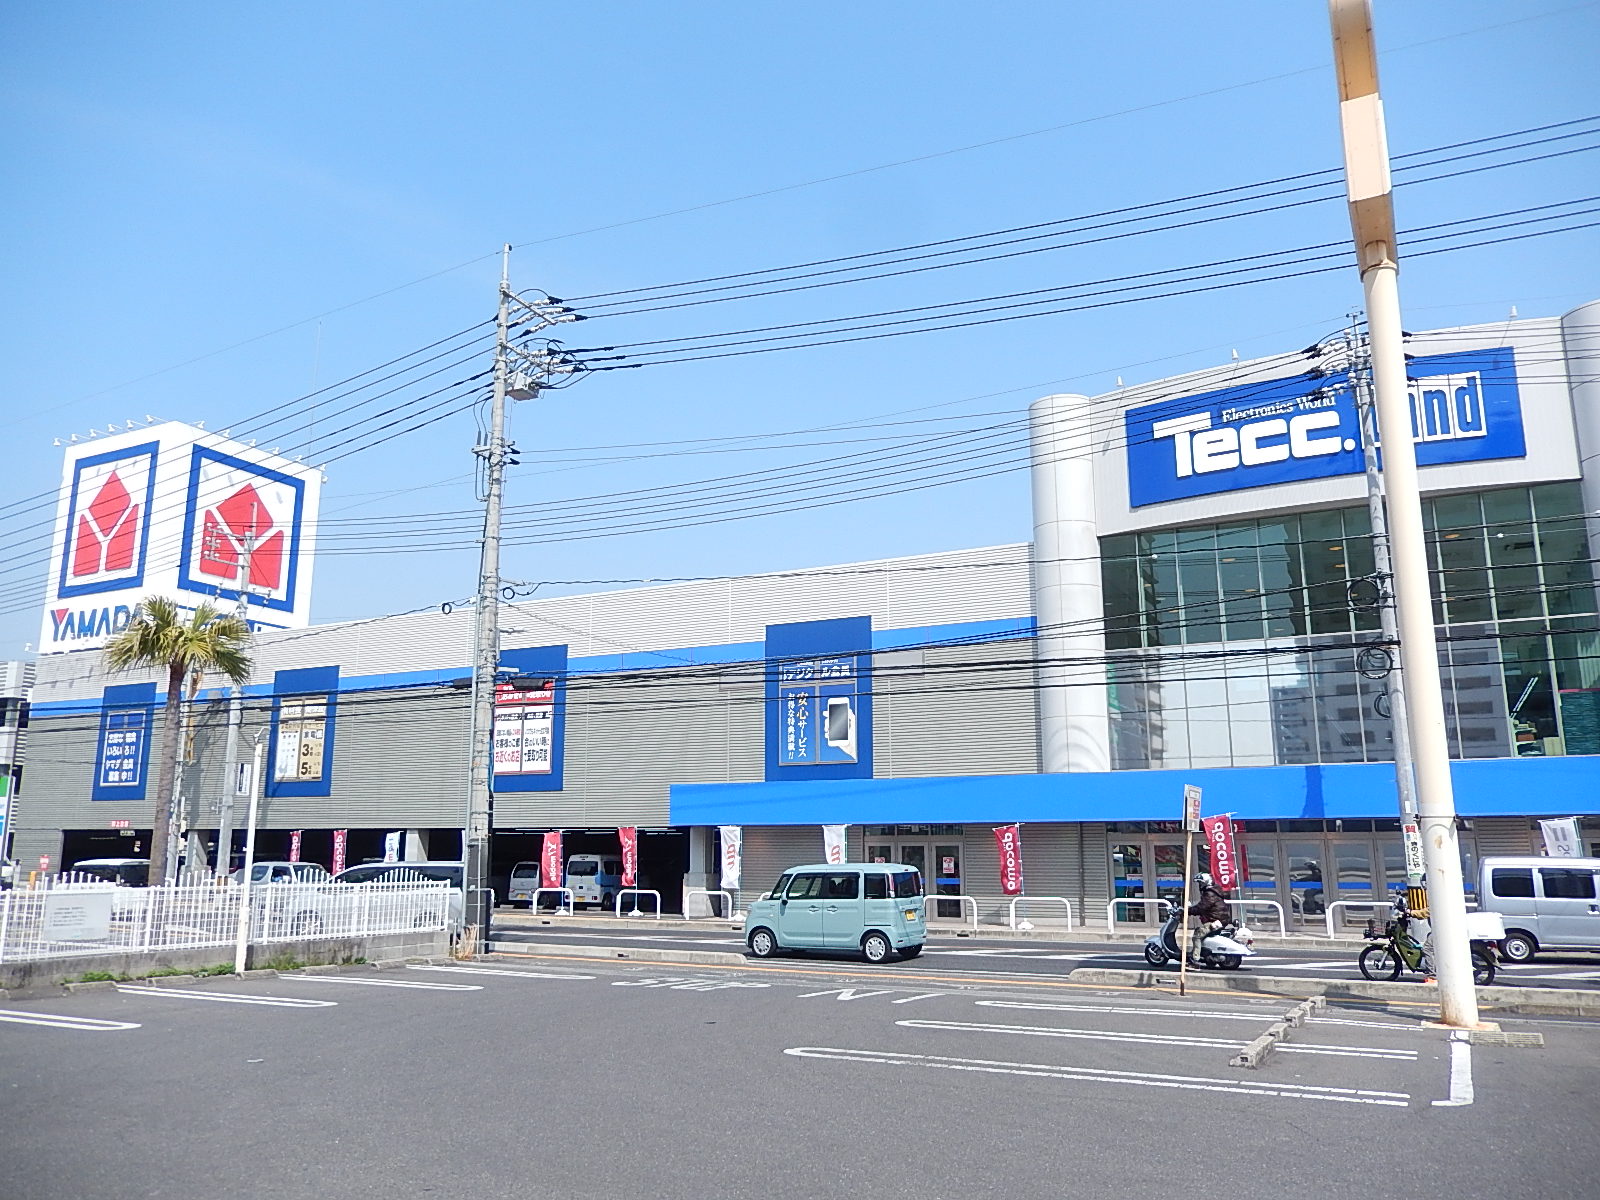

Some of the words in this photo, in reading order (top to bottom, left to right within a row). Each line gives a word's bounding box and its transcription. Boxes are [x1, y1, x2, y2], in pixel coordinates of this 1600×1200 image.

[1222, 401, 1293, 423] Electronics
[1296, 394, 1336, 412] World
[1152, 411, 1355, 478] Tecc.
[796, 691, 809, 757] 安心サービス
